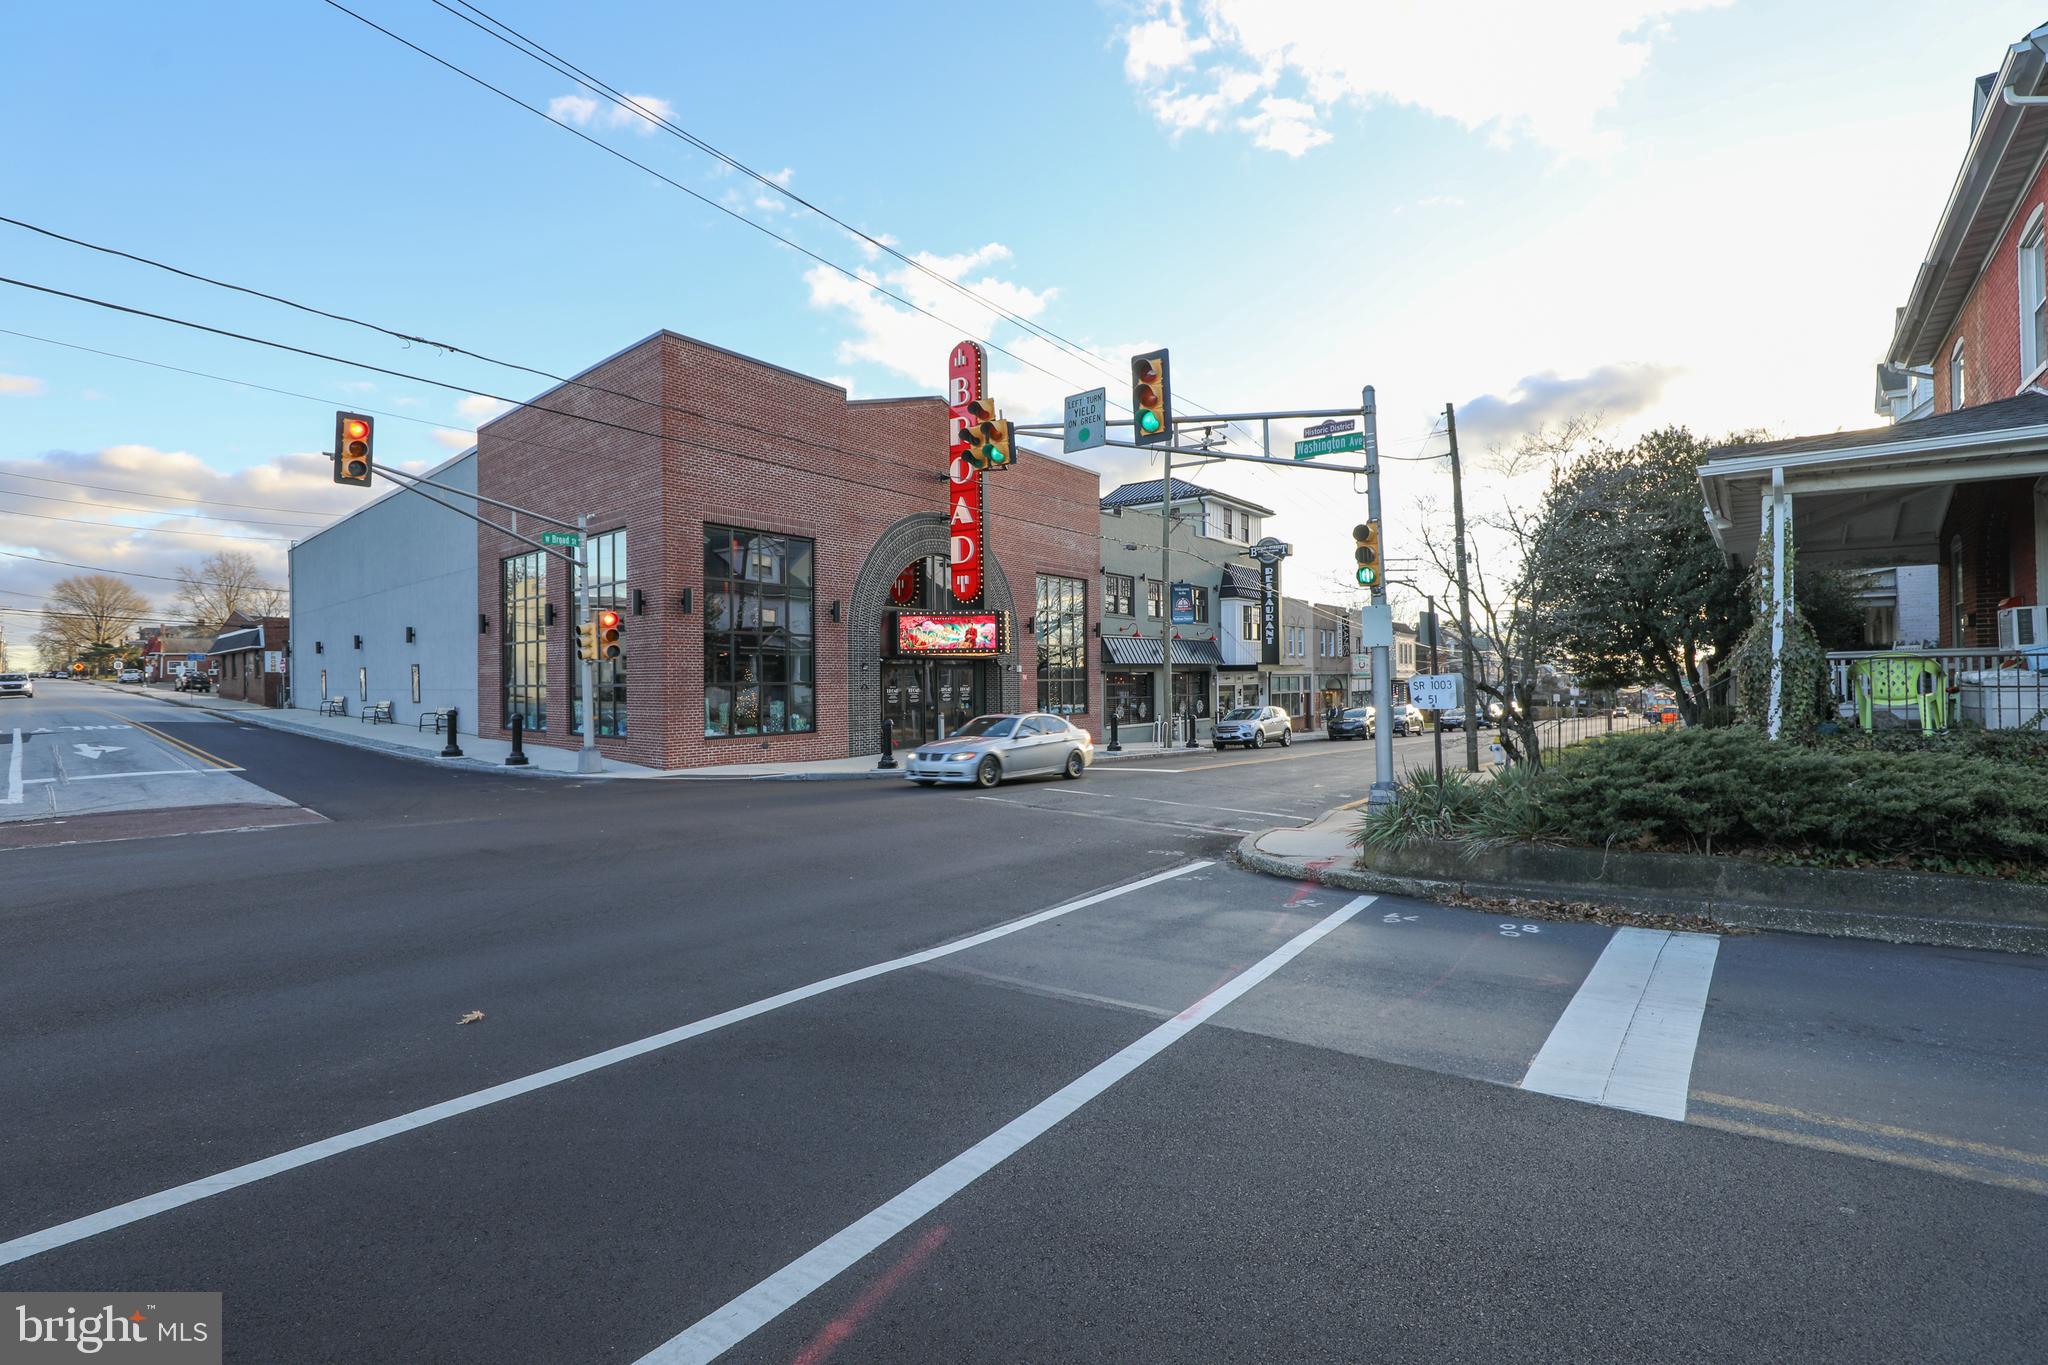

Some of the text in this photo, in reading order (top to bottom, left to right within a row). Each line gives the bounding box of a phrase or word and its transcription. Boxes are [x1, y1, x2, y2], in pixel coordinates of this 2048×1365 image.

[1068, 393, 1102, 409] LEFT TURN
[1074, 405, 1096, 417] YIELD
[1068, 414, 1101, 428] ON GREEN
[1304, 422, 1354, 436] Historic District
[1296, 436, 1363, 455] Washington Ave
[950, 377, 974, 565] BROAD
[551, 534, 570, 545] Broad
[1264, 567, 1275, 645] RESTAURANT
[1413, 680, 1453, 690] SR 1003
[1428, 694, 1438, 704] 51
